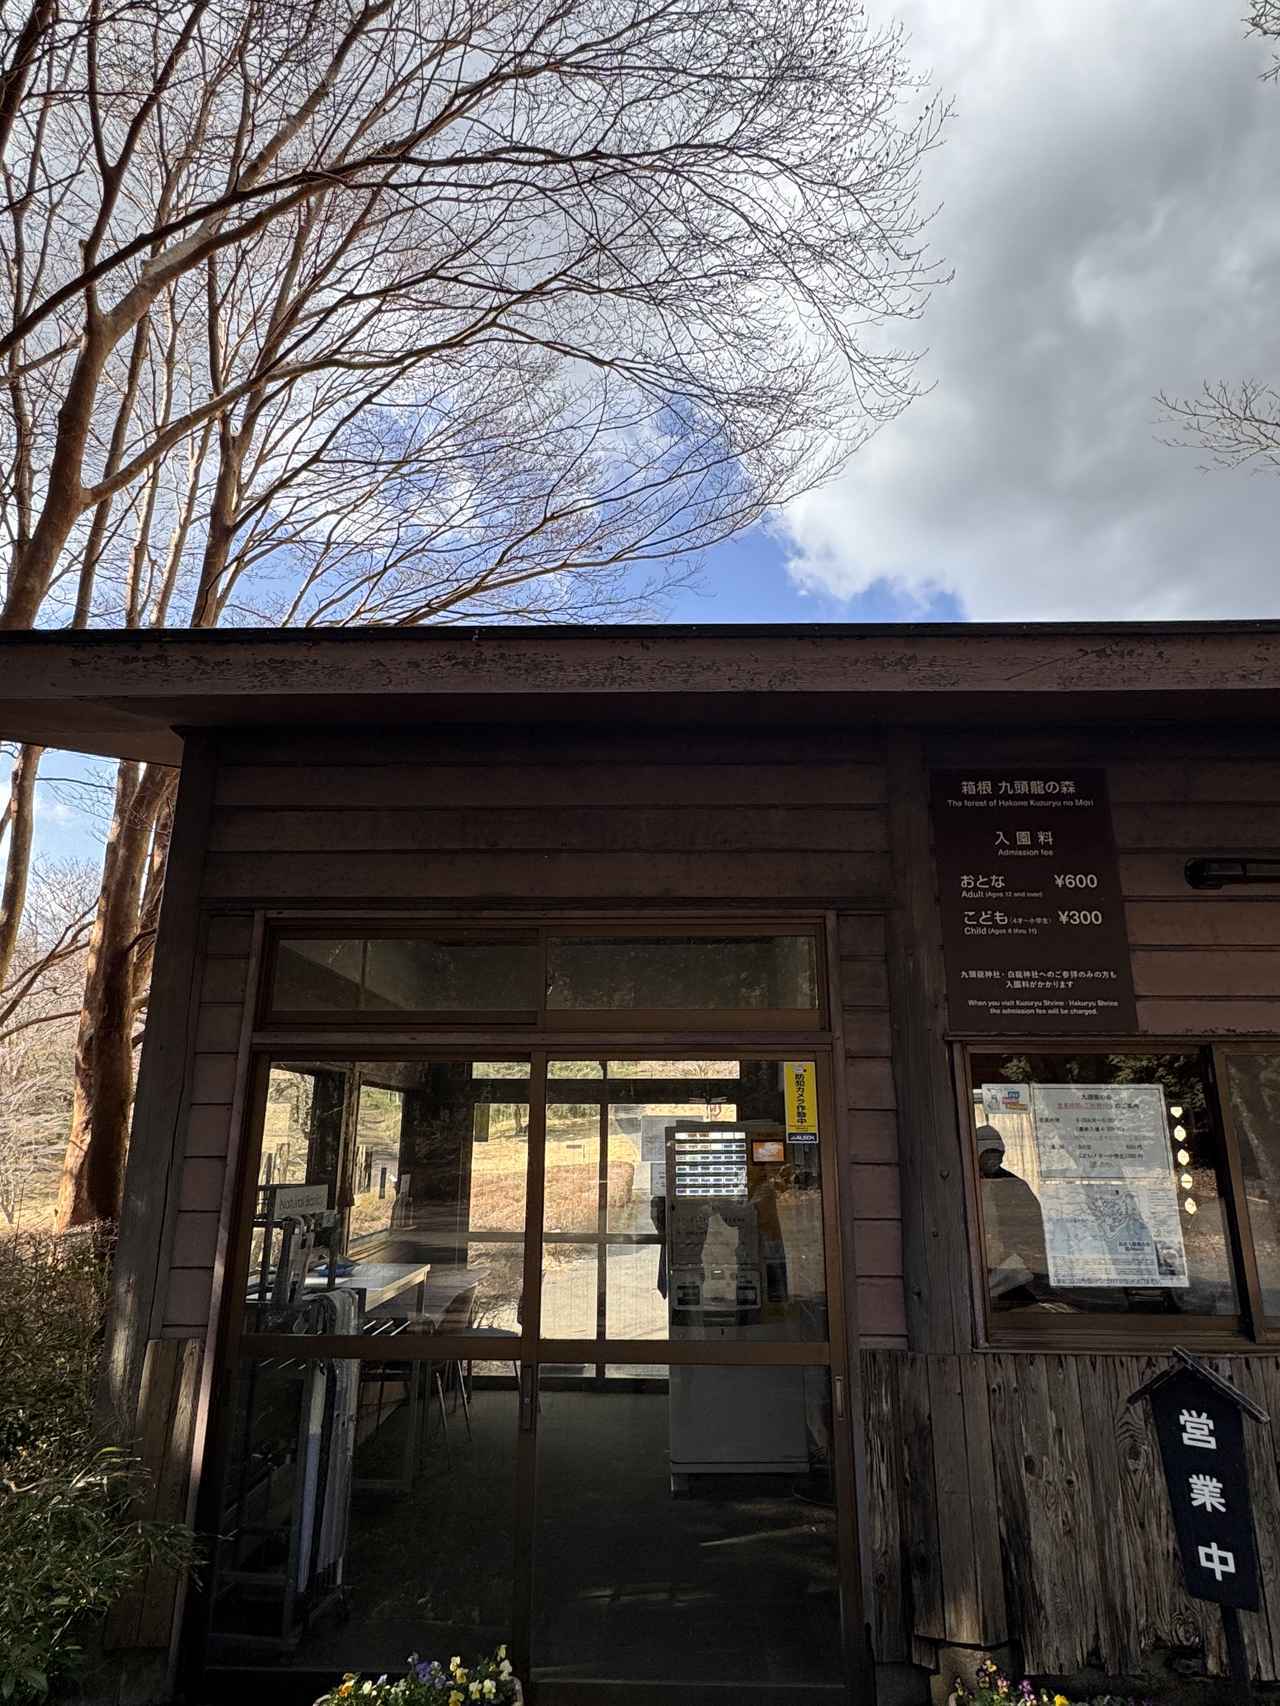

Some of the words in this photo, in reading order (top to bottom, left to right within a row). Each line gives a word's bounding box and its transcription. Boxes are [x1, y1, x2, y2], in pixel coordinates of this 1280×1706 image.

[961, 781, 992, 795] 箱根
[998, 781, 1076, 795] 九頭龍の森
[960, 874, 1006, 889] おとな
[1054, 874, 1098, 888] ¥600
[961, 890, 985, 898] Adult
[964, 911, 1008, 925] こども
[1058, 911, 1102, 925] ¥300
[964, 927, 987, 935] Child
[795, 1074, 807, 1123] 防犯カメラ作動中
[1178, 1408, 1236, 1581] 営業中
